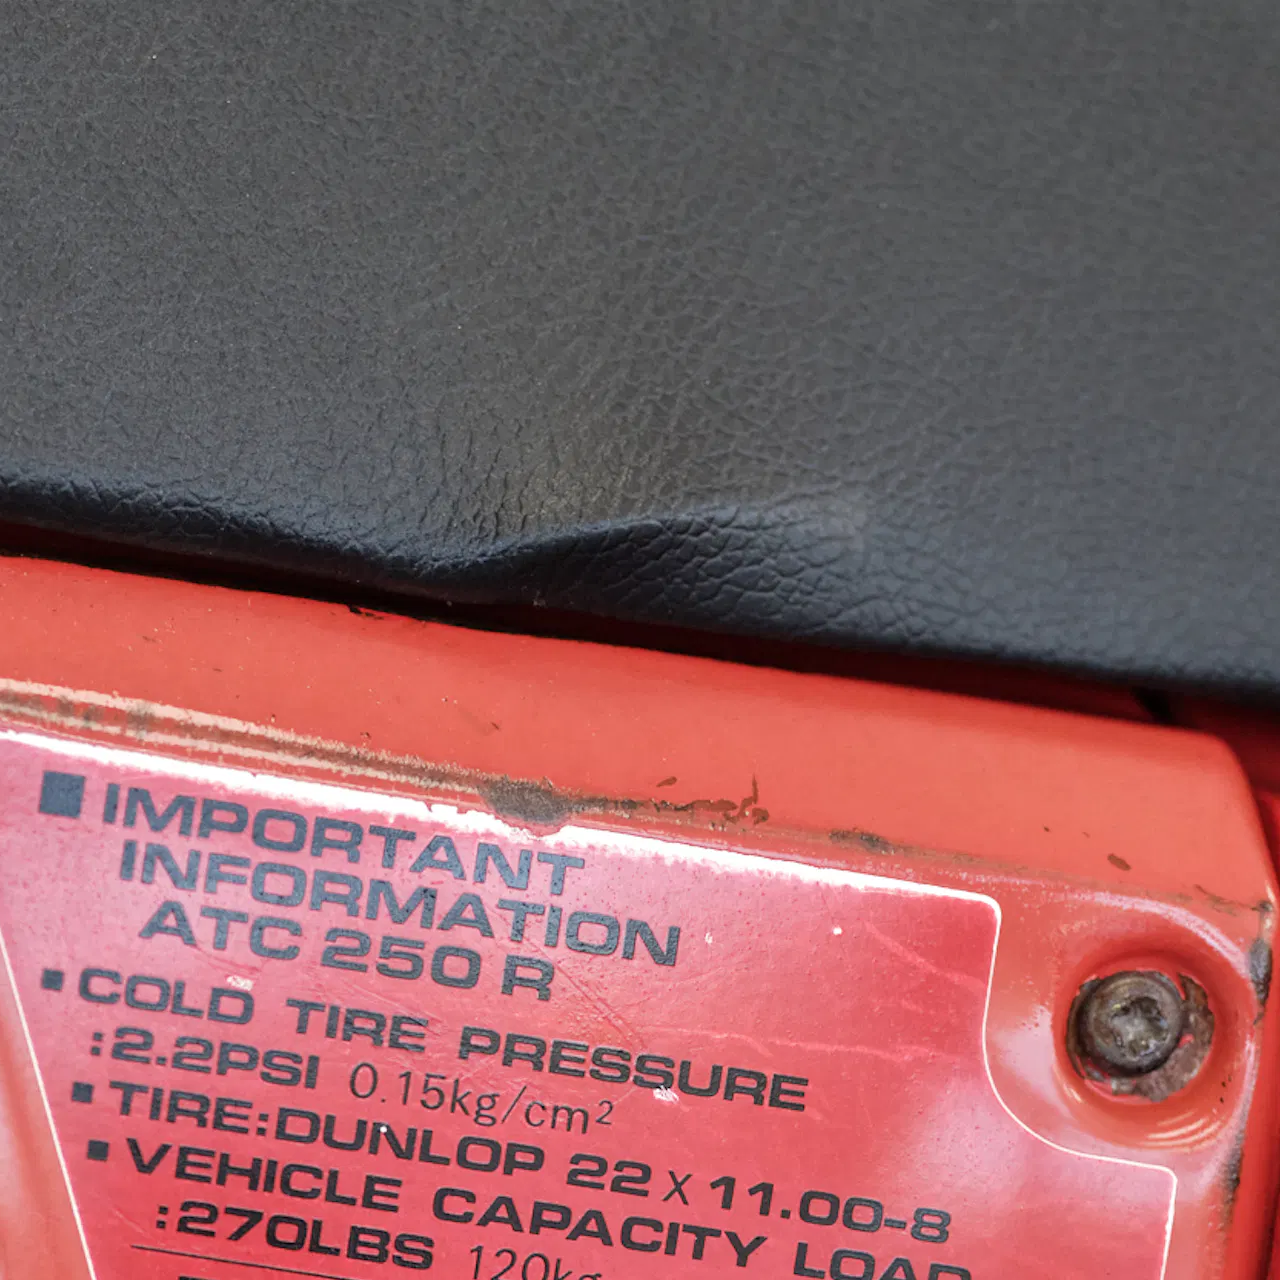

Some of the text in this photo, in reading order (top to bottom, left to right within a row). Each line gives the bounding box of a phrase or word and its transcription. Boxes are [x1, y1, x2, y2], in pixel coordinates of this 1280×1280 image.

[103, 783, 585, 896] IMPORTANT
[120, 840, 681, 967] INFORMATION
[139, 900, 554, 1001] ATC 250 R
[79, 968, 809, 1112] COLD TIRE PRESSURE
[126, 1137, 403, 1213] VEHICLE
[433, 1187, 768, 1267] CAPACITY
[566, 1153, 652, 1197] 22
[710, 1176, 951, 1243] 11.00-8
